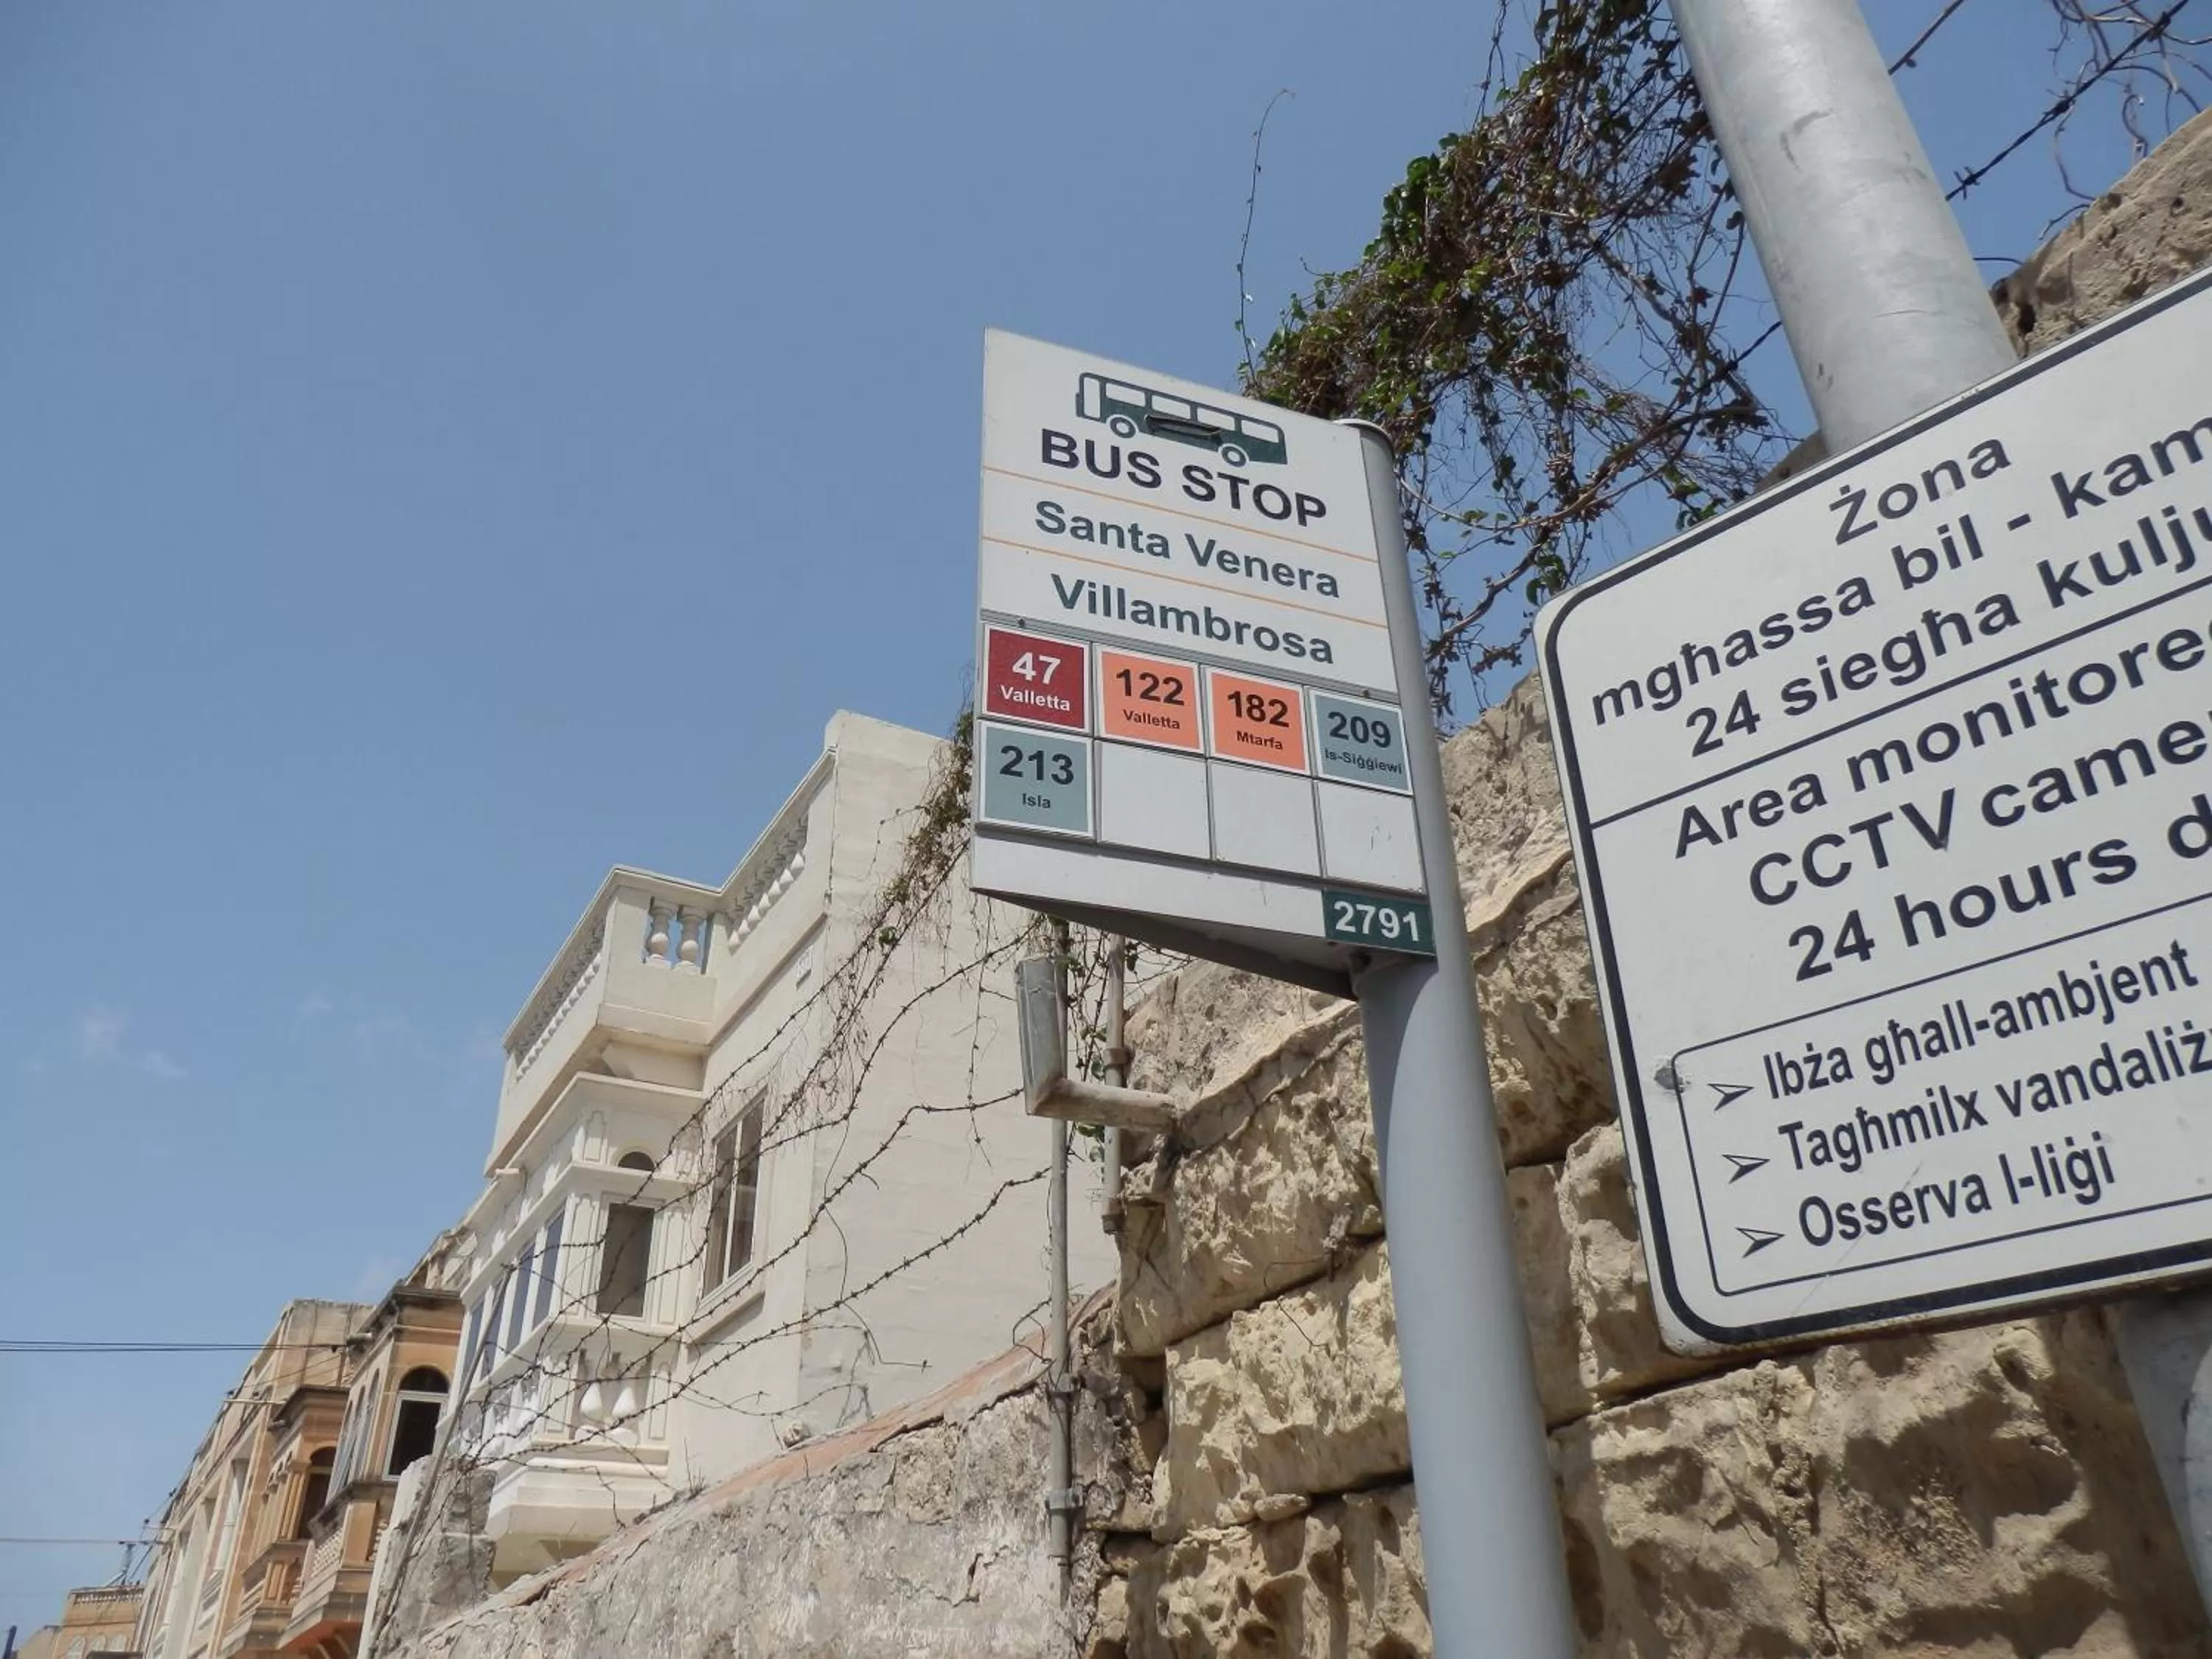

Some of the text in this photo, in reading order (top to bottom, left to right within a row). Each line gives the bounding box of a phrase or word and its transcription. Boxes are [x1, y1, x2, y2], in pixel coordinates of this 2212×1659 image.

[1042, 428, 1326, 526] BUS STOP
[1829, 439, 2011, 546] Żona
[1035, 501, 1339, 598] Santa Venera
[1050, 574, 1333, 664] Villambrosa
[1593, 577, 1876, 726] mgħassa
[1891, 514, 1983, 590] bil
[1001, 685, 1071, 712] Valletta
[1012, 653, 1060, 684] 47
[1116, 669, 1184, 706] 122
[1228, 691, 1289, 728] 182
[1686, 689, 1761, 757] 24
[1781, 594, 2020, 715] siegħa
[1122, 709, 1180, 730] Valletta
[1237, 730, 1283, 751] Mtarfa
[1325, 748, 1402, 774] Is-Siġġiewi
[1328, 712, 1391, 748] 209
[1675, 621, 2212, 859] Area monitore
[1000, 745, 1074, 785] 213
[1023, 793, 1051, 809] Isla
[1750, 711, 2212, 905] CCTV came
[1334, 901, 1419, 942] 2791
[1789, 910, 1875, 982] 24
[1893, 839, 2137, 947] hours
[1764, 939, 2199, 1099] Ibża għall-ambjent
[1778, 1020, 2212, 1172] Tagħmilx vandaliż
[1799, 1131, 2115, 1246] Osserva l-liġi
